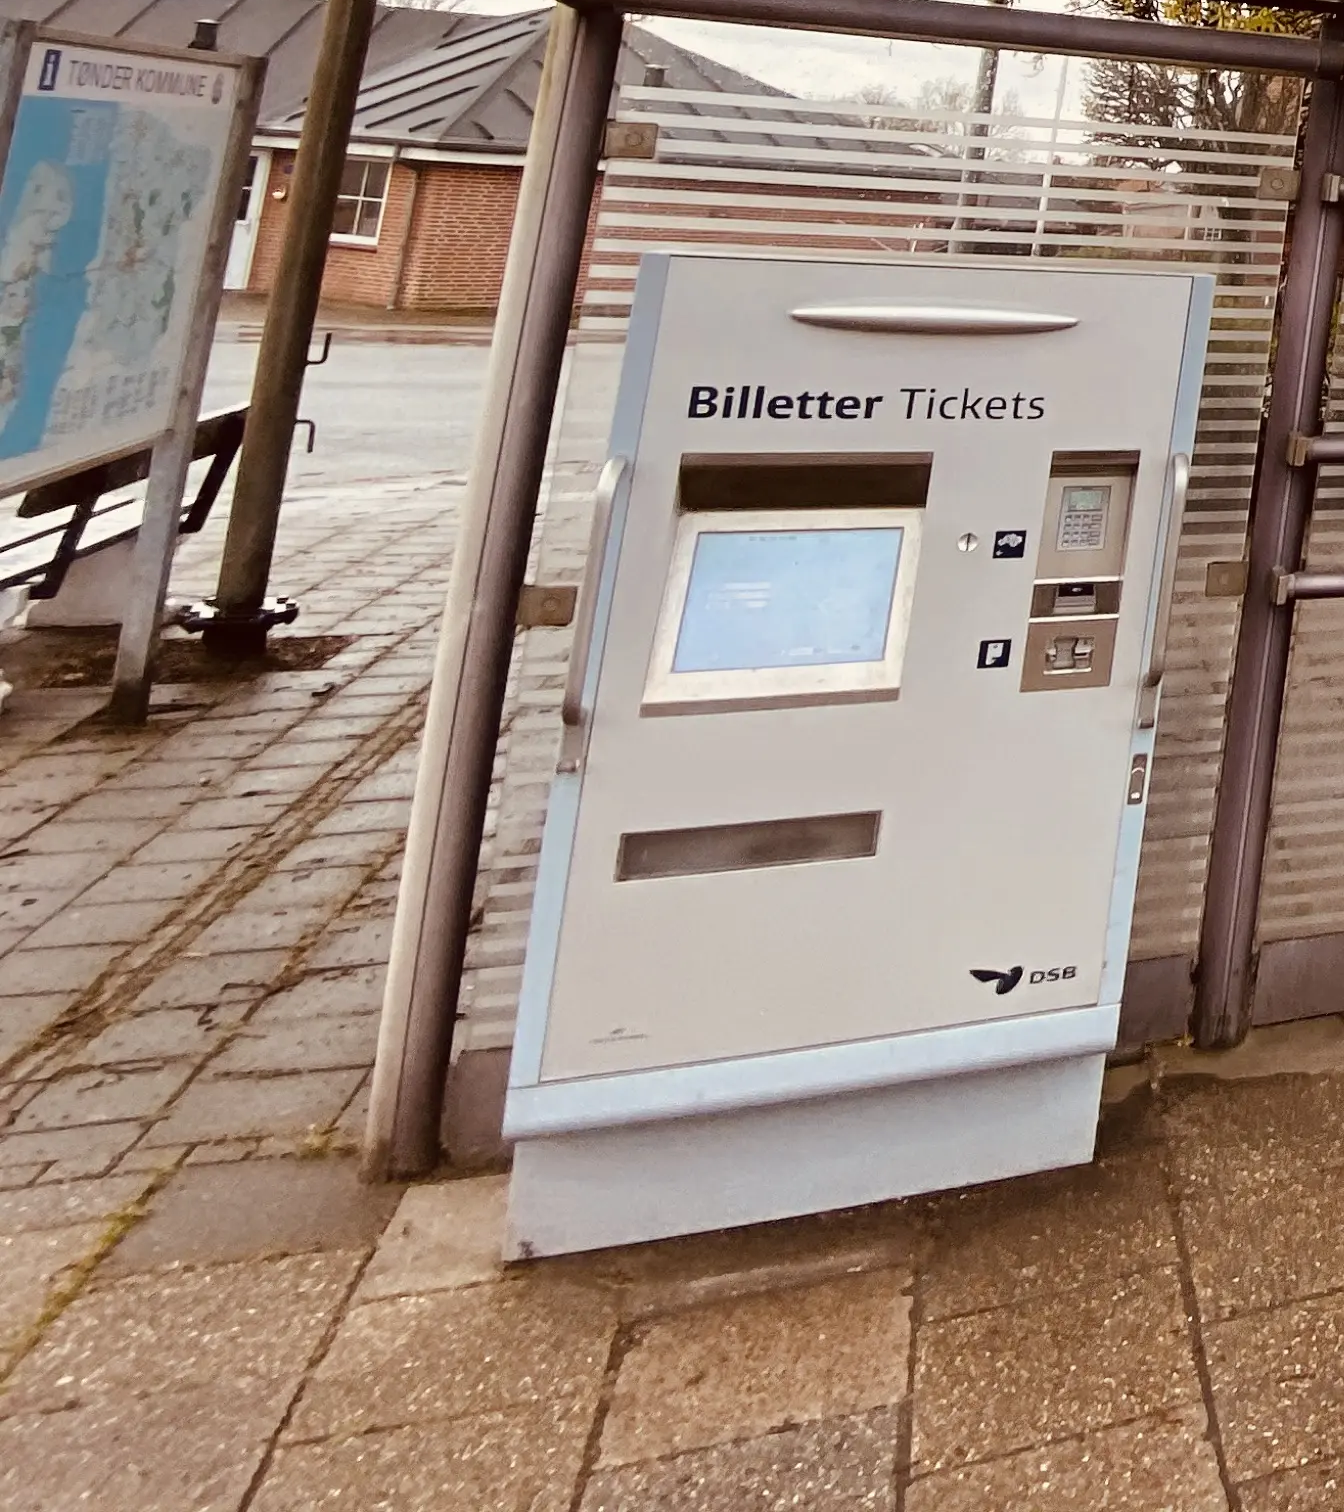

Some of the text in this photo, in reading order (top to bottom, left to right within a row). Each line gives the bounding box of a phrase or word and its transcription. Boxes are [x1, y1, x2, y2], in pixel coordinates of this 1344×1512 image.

[69, 60, 133, 90] TØNDER
[136, 68, 208, 97] KOMMUNE
[687, 385, 1045, 420] Billetter Tickets
[1029, 965, 1077, 984] DSB
